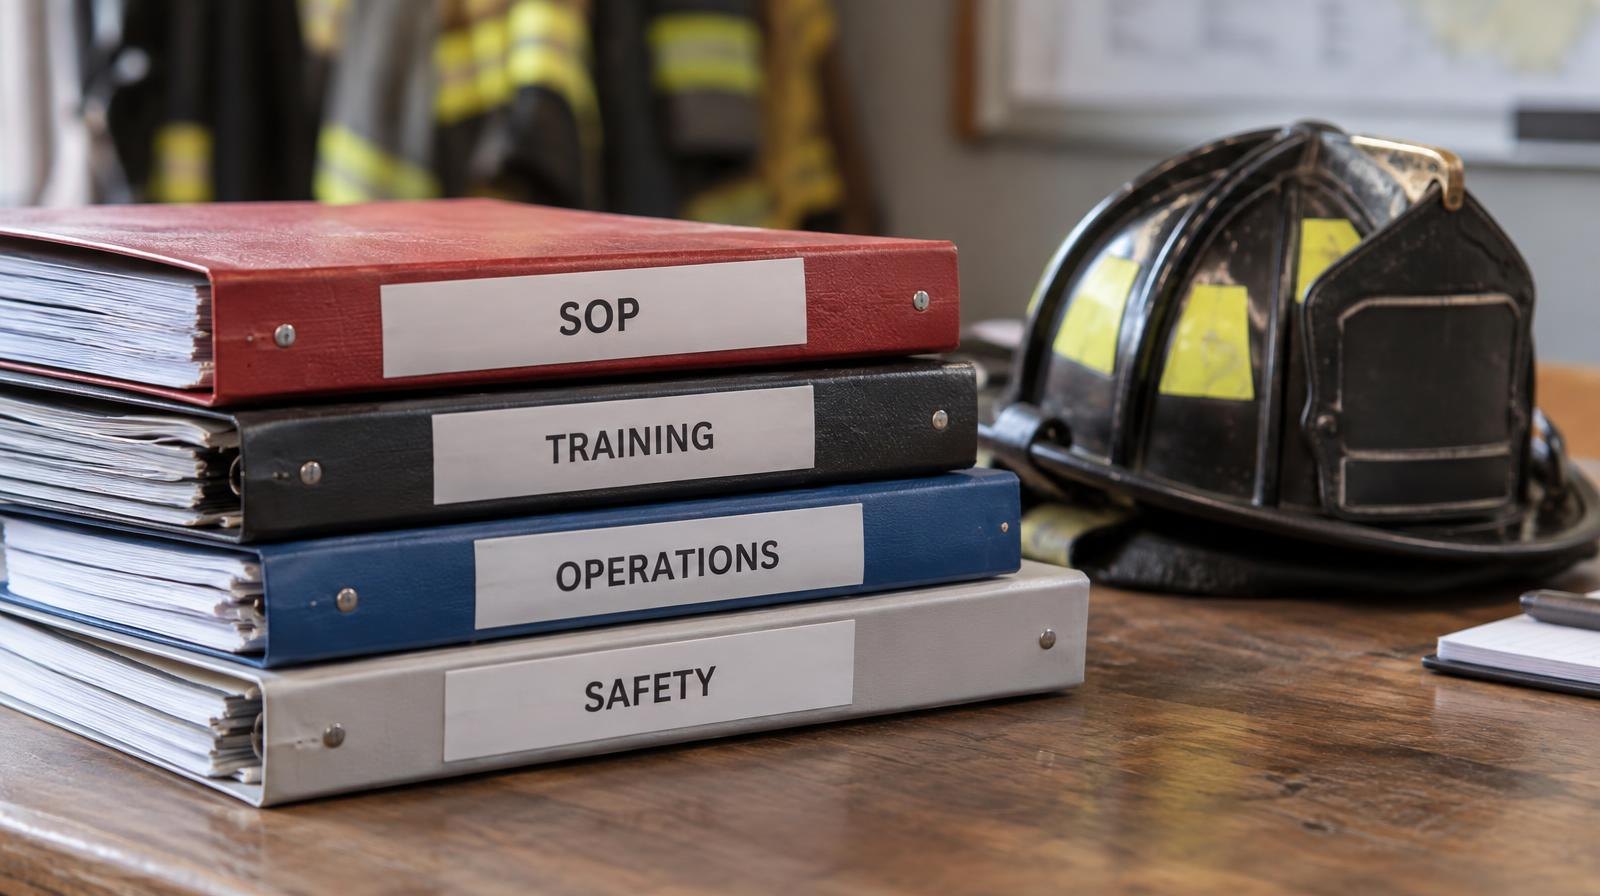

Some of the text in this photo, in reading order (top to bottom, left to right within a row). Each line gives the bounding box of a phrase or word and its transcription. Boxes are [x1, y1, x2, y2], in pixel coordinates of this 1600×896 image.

[559, 297, 640, 337] SOP
[545, 421, 714, 465] TRAINING
[556, 539, 780, 593] OPERATIONS
[584, 665, 717, 713] SAFETY
